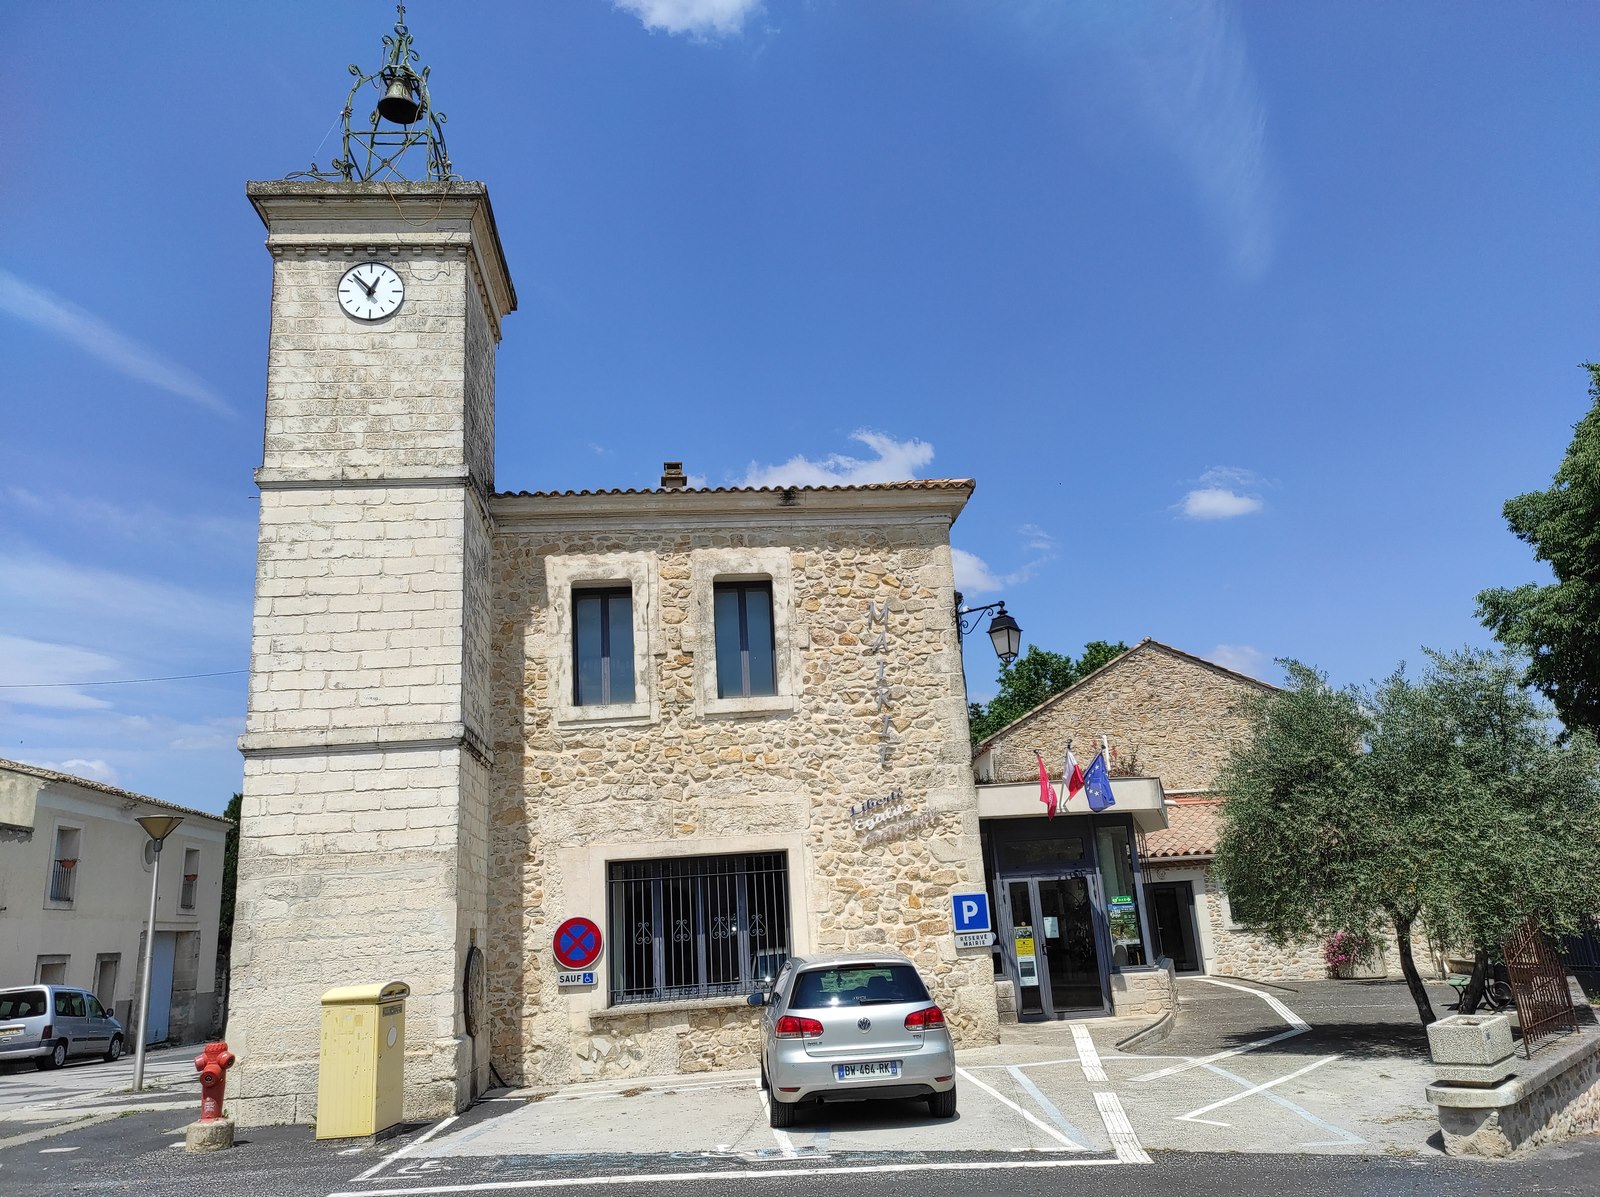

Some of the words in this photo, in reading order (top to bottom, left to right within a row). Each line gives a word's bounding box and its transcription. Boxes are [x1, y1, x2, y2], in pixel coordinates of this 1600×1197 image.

[867, 599, 894, 767] MAIRIE
[850, 787, 904, 817] Liberté
[962, 900, 979, 925] P
[963, 939, 986, 947] MAIRIE
[559, 974, 582, 983] SAUF
[845, 1062, 890, 1076] BW-464-RK
